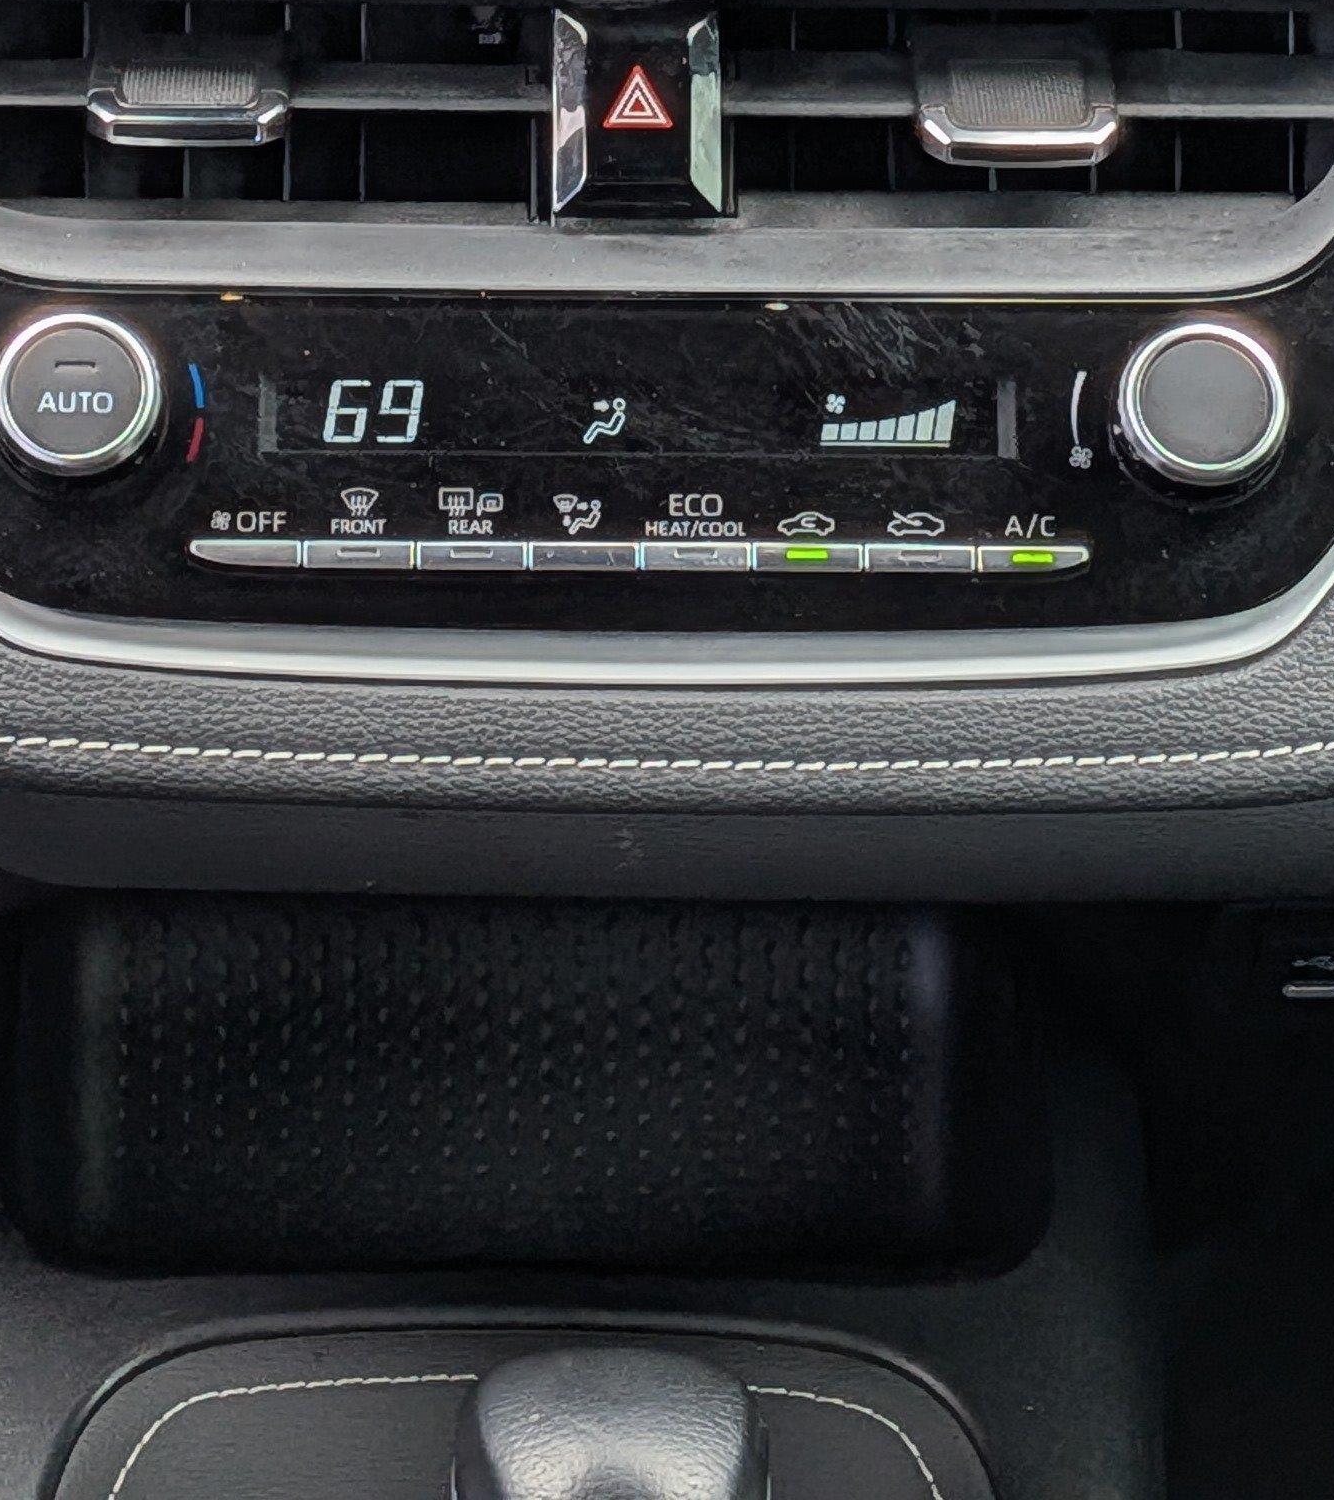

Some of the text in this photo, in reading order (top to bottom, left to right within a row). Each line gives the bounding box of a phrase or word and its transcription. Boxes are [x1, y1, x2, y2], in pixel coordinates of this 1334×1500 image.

[37, 391, 114, 414] AUTO
[322, 379, 424, 443] 69
[668, 493, 723, 517] ECO
[236, 511, 287, 533] OFF
[330, 518, 387, 534] FRONT
[447, 519, 494, 535] REAR
[644, 519, 746, 538] HEAT/COOL
[1004, 514, 1056, 538] A/C
